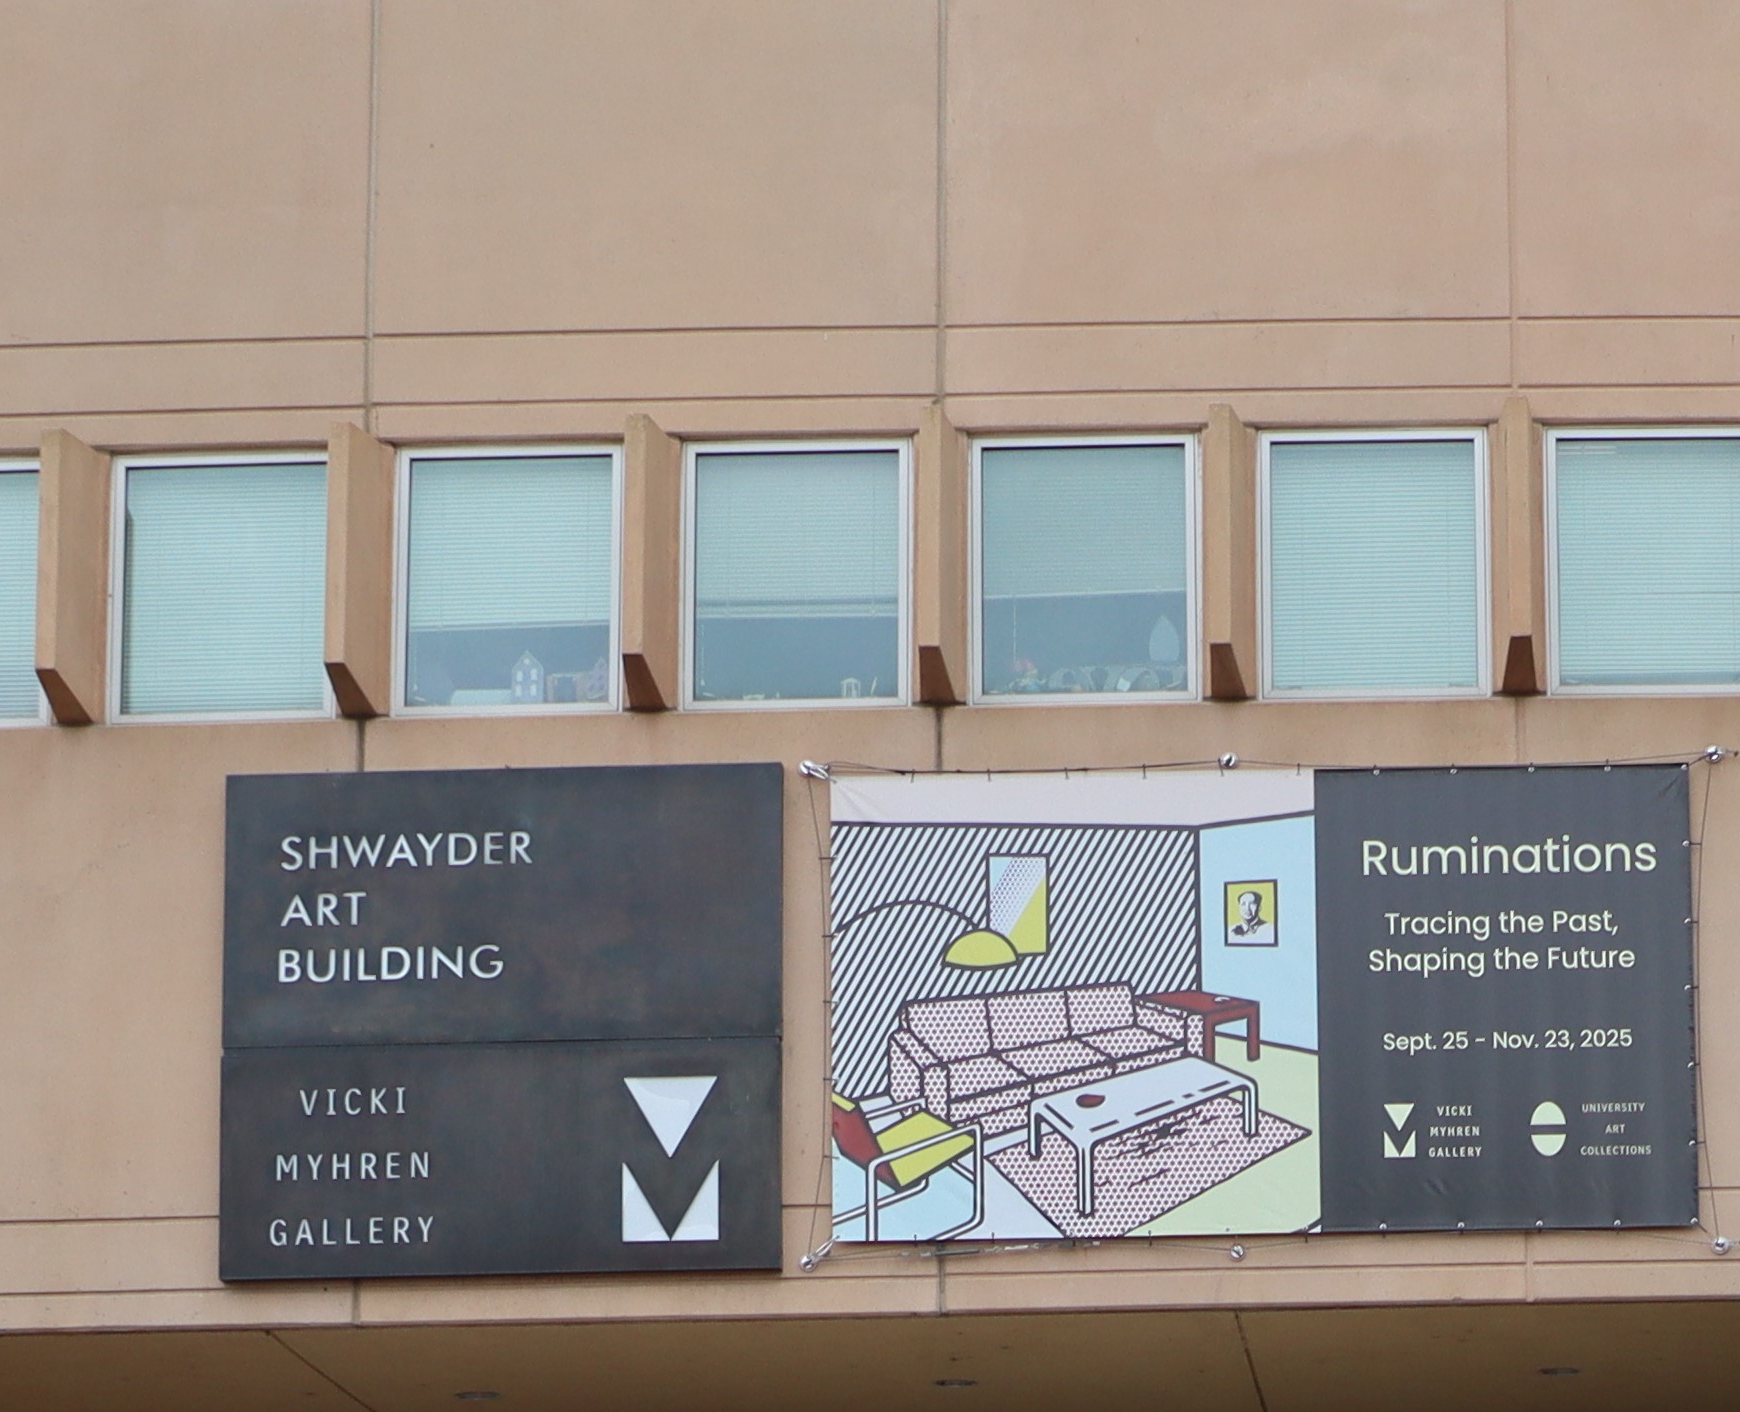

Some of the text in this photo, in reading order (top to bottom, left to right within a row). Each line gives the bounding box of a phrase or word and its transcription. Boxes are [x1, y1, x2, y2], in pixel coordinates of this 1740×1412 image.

[281, 831, 532, 871] SHWAYDER
[1362, 834, 1657, 876] Ruminations
[280, 892, 367, 927] ART
[1384, 910, 1618, 941] Tracing the Past,
[278, 944, 504, 983] BUILDING
[1369, 946, 1636, 979] Shaping the Future
[1383, 1032, 1437, 1056] Sept.
[1442, 1031, 1469, 1050] 25
[1493, 1031, 1539, 1049] Nov.
[1544, 1029, 1575, 1051] 23,
[1580, 1028, 1633, 1048] 2025
[299, 1087, 406, 1116] VICKI
[1436, 1105, 1472, 1117] VICKI
[1581, 1102, 1645, 1113] UNIVERSITY
[1429, 1125, 1480, 1137] MYHREN
[1605, 1123, 1626, 1134] ART
[1428, 1146, 1482, 1158] GALLERY
[1580, 1144, 1652, 1156] COLLECTIONS
[276, 1151, 429, 1181] MYHREN
[269, 1216, 434, 1247] GALLERY
